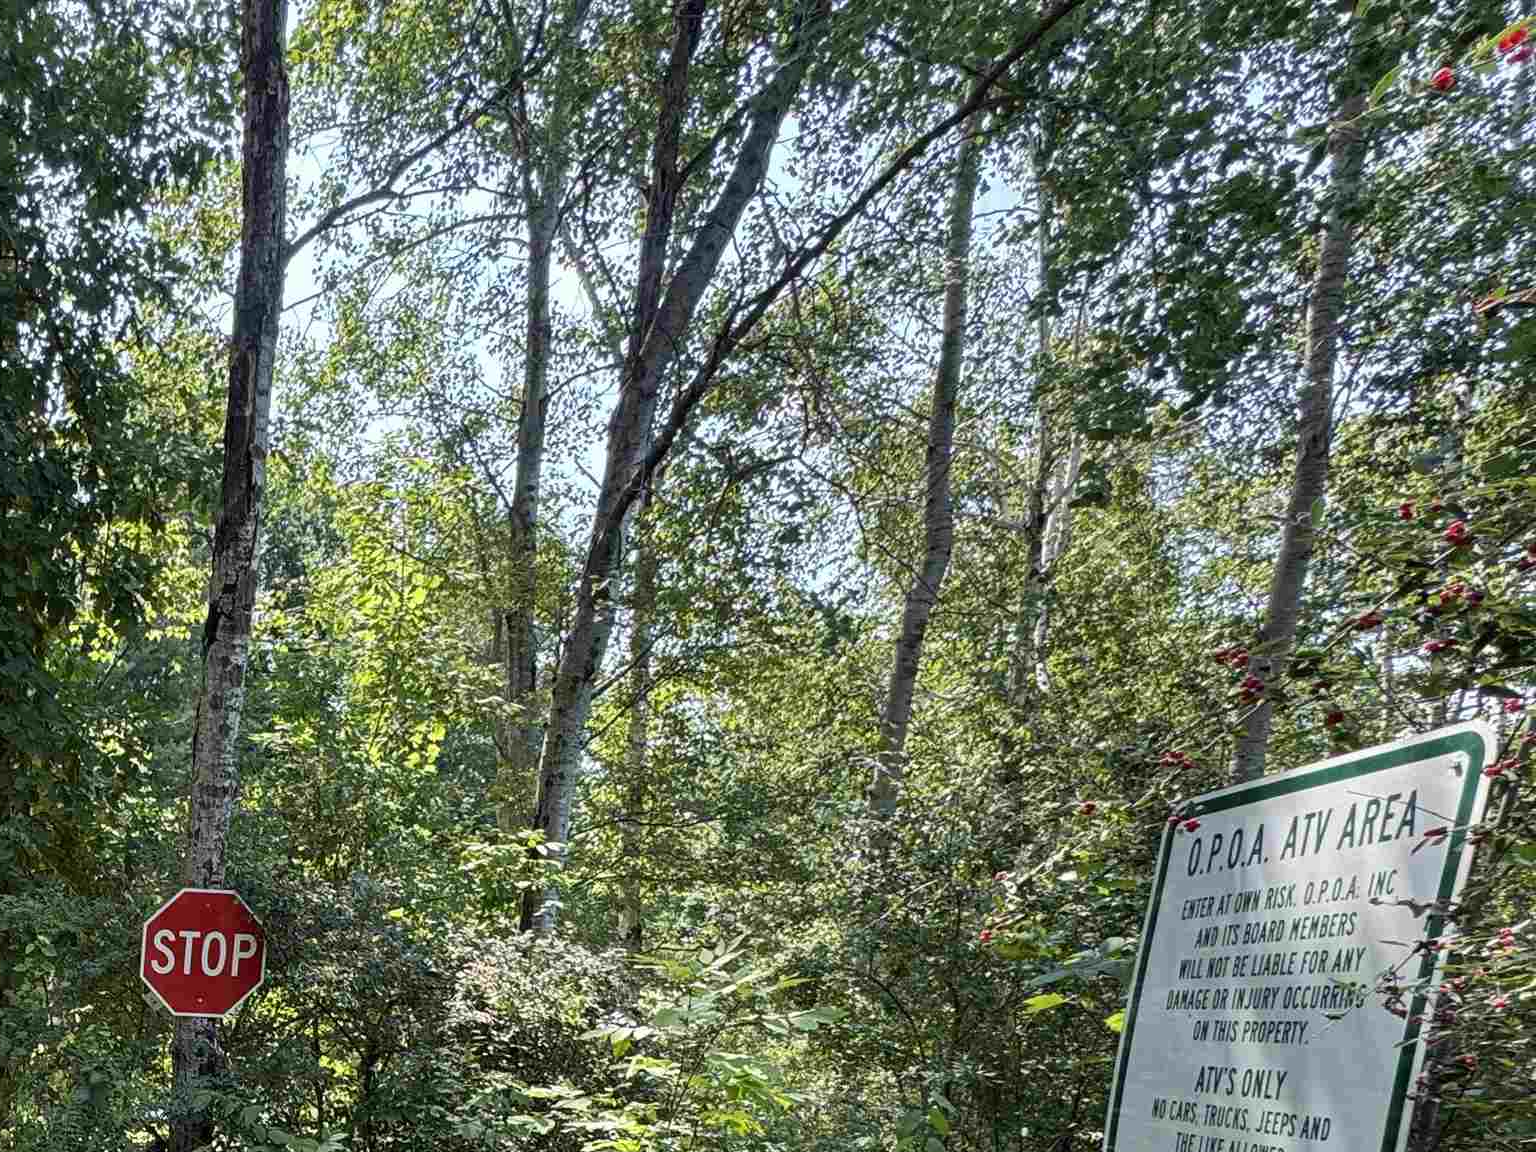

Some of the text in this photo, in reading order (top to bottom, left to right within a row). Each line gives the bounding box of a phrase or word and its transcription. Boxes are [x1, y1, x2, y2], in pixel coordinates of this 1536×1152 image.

[1187, 790, 1417, 877] O.P.O.A. ATV AREA
[1182, 895, 1214, 921] ENTER
[1216, 893, 1232, 915] AT
[1233, 889, 1261, 913] OWN
[1264, 883, 1297, 910] RISK.
[1195, 912, 1357, 949] AND ITS BOARD MEMBERS
[150, 929, 257, 977] STOP
[1179, 947, 1366, 979] WILL NOT BE LIABLE FOR ANY
[1166, 989, 1210, 1010] DAMAGE
[1213, 988, 1229, 1010] OR
[1231, 987, 1280, 1010] INJURY
[1192, 1020, 1309, 1045] ON THIS PROPERTY.
[1194, 1065, 1288, 1100] ATV'S ONLY
[1152, 1098, 1167, 1120] NO
[1256, 1110, 1297, 1137] JEEPS
[1299, 1115, 1331, 1141] AND
